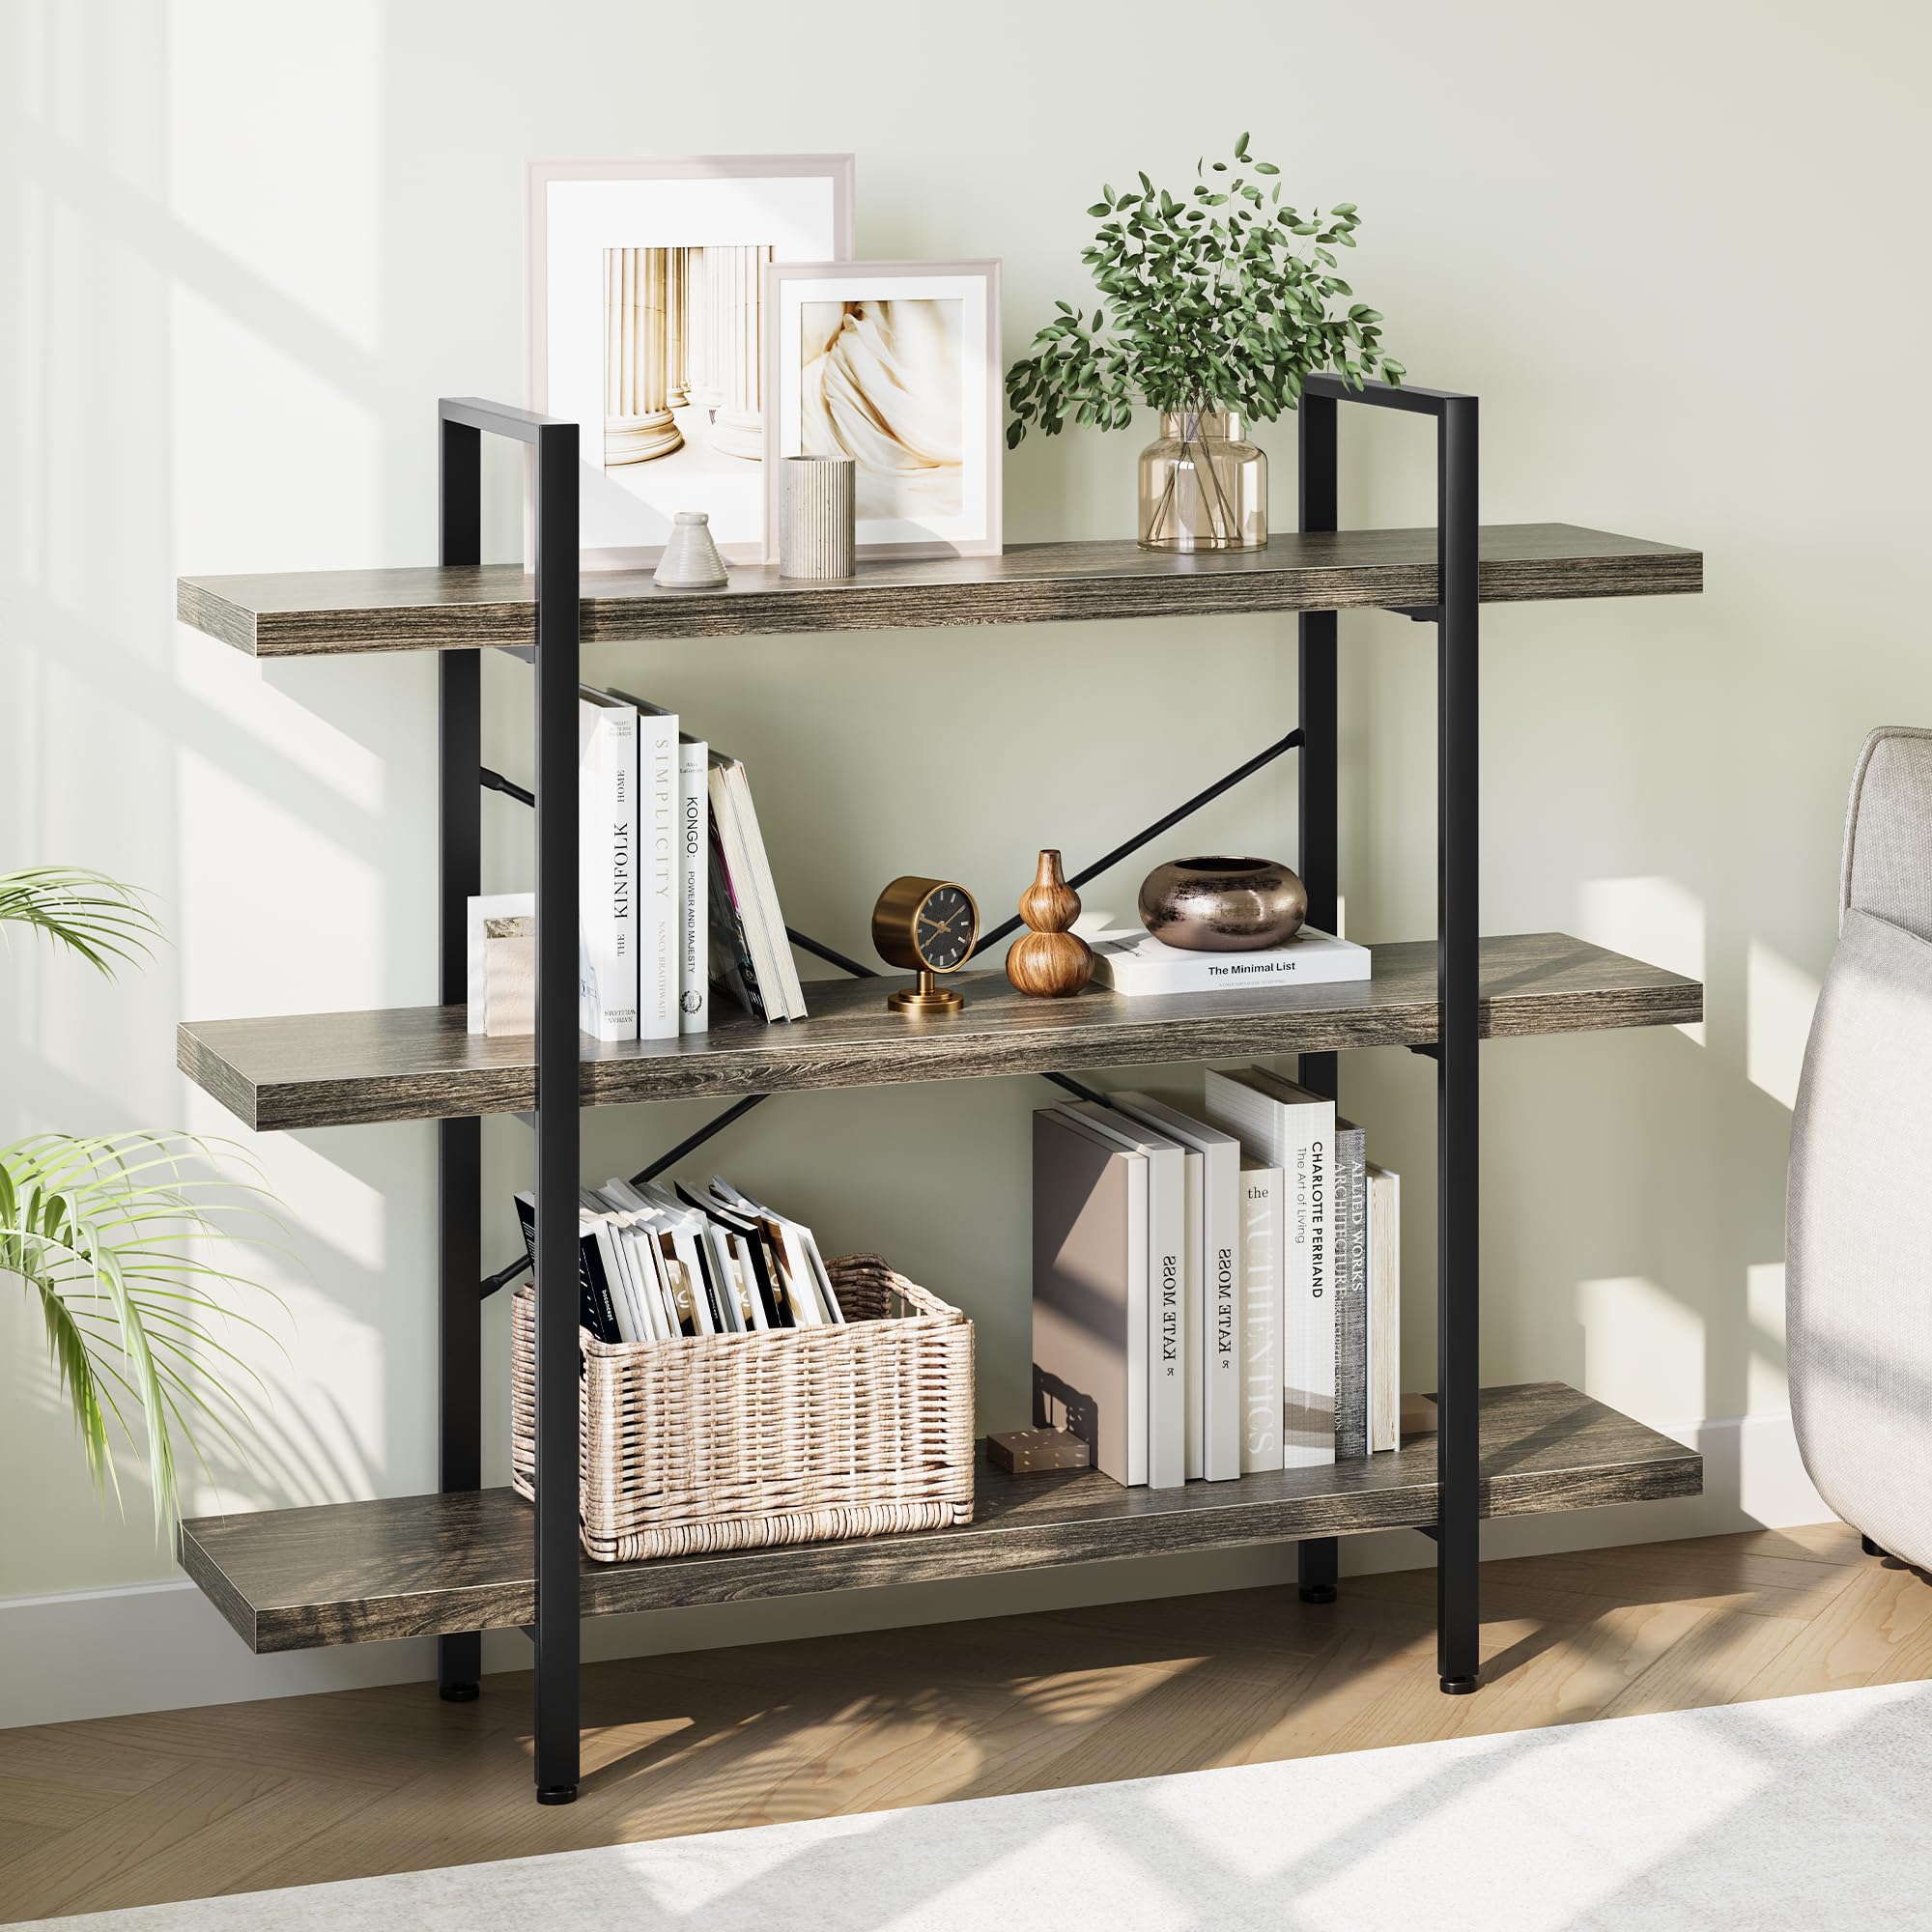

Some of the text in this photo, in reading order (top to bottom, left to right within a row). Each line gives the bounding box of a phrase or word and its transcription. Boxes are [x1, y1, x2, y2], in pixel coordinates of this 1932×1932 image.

[613, 770, 629, 957] THE KINFOLK HOME
[655, 739, 669, 897] SIMPLICITY
[686, 797, 698, 858] KONGO:
[1208, 961, 1296, 976] The Minimal List
[1247, 1186, 1268, 1200] the
[1295, 1148, 1307, 1244] The Art of Living
[1312, 1141, 1322, 1298] CHARLOTTE PERRIAND
[1351, 1161, 1362, 1292] ALLIED WORKS
[601, 1289, 613, 1321] boconcept
[1246, 1203, 1274, 1455] AUTHENTICS
